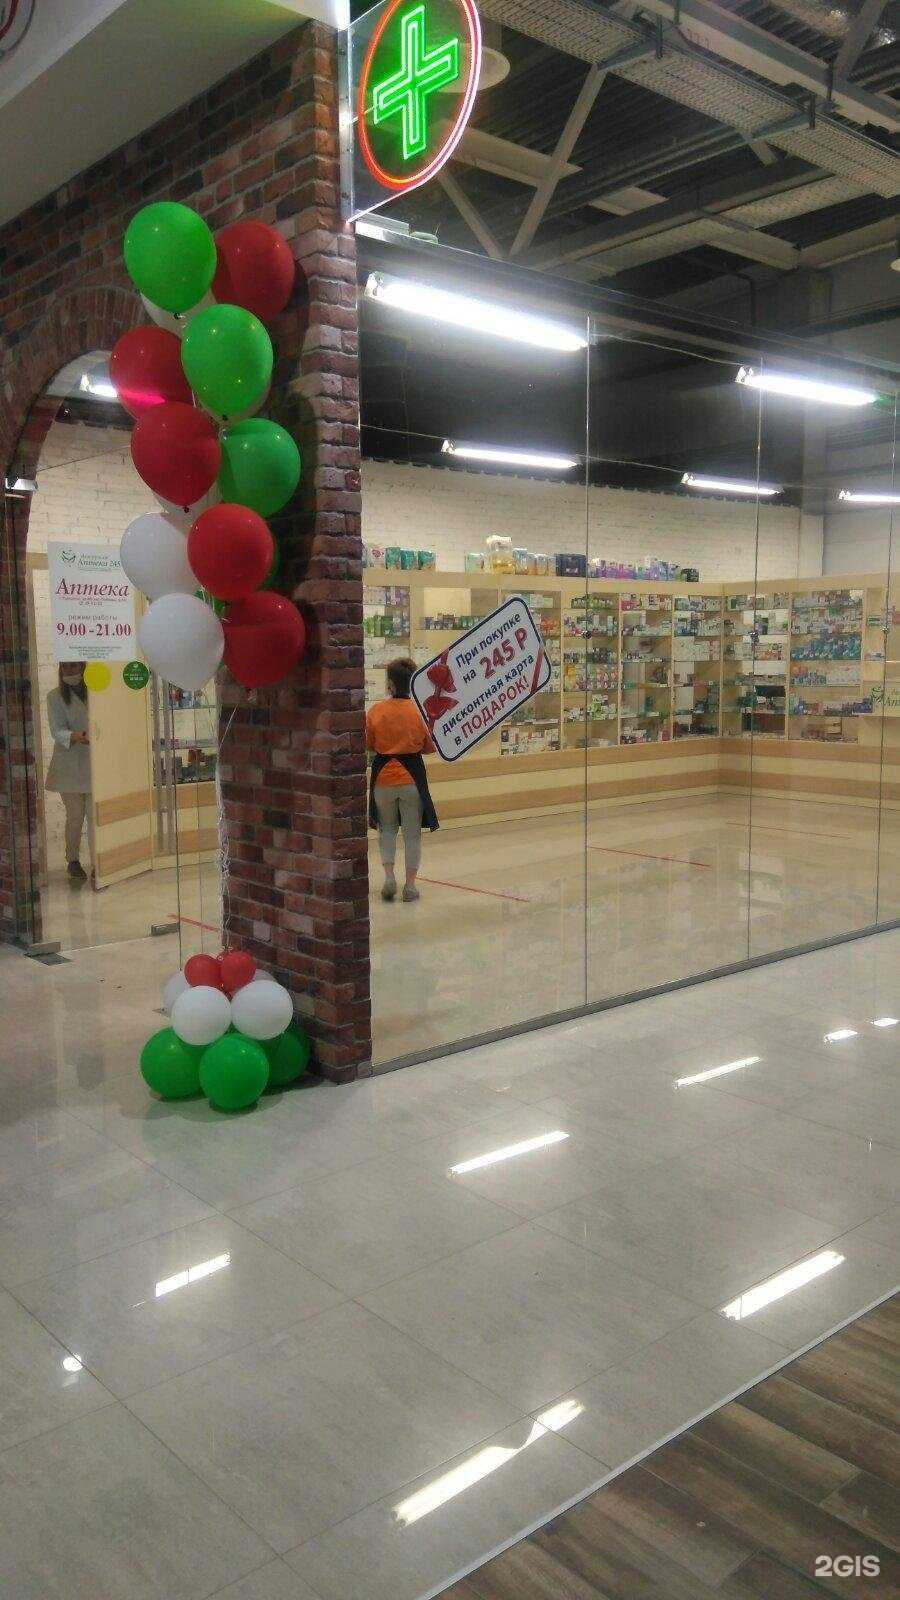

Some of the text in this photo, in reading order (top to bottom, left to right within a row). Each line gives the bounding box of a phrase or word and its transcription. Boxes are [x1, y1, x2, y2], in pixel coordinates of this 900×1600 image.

[56, 577, 129, 597] Аптека
[455, 613, 521, 668] При покупке
[462, 669, 477, 684] на
[479, 638, 516, 679] 245
[441, 653, 534, 737] дисконтная карта
[454, 675, 530, 746] в ПОДАРОК!
